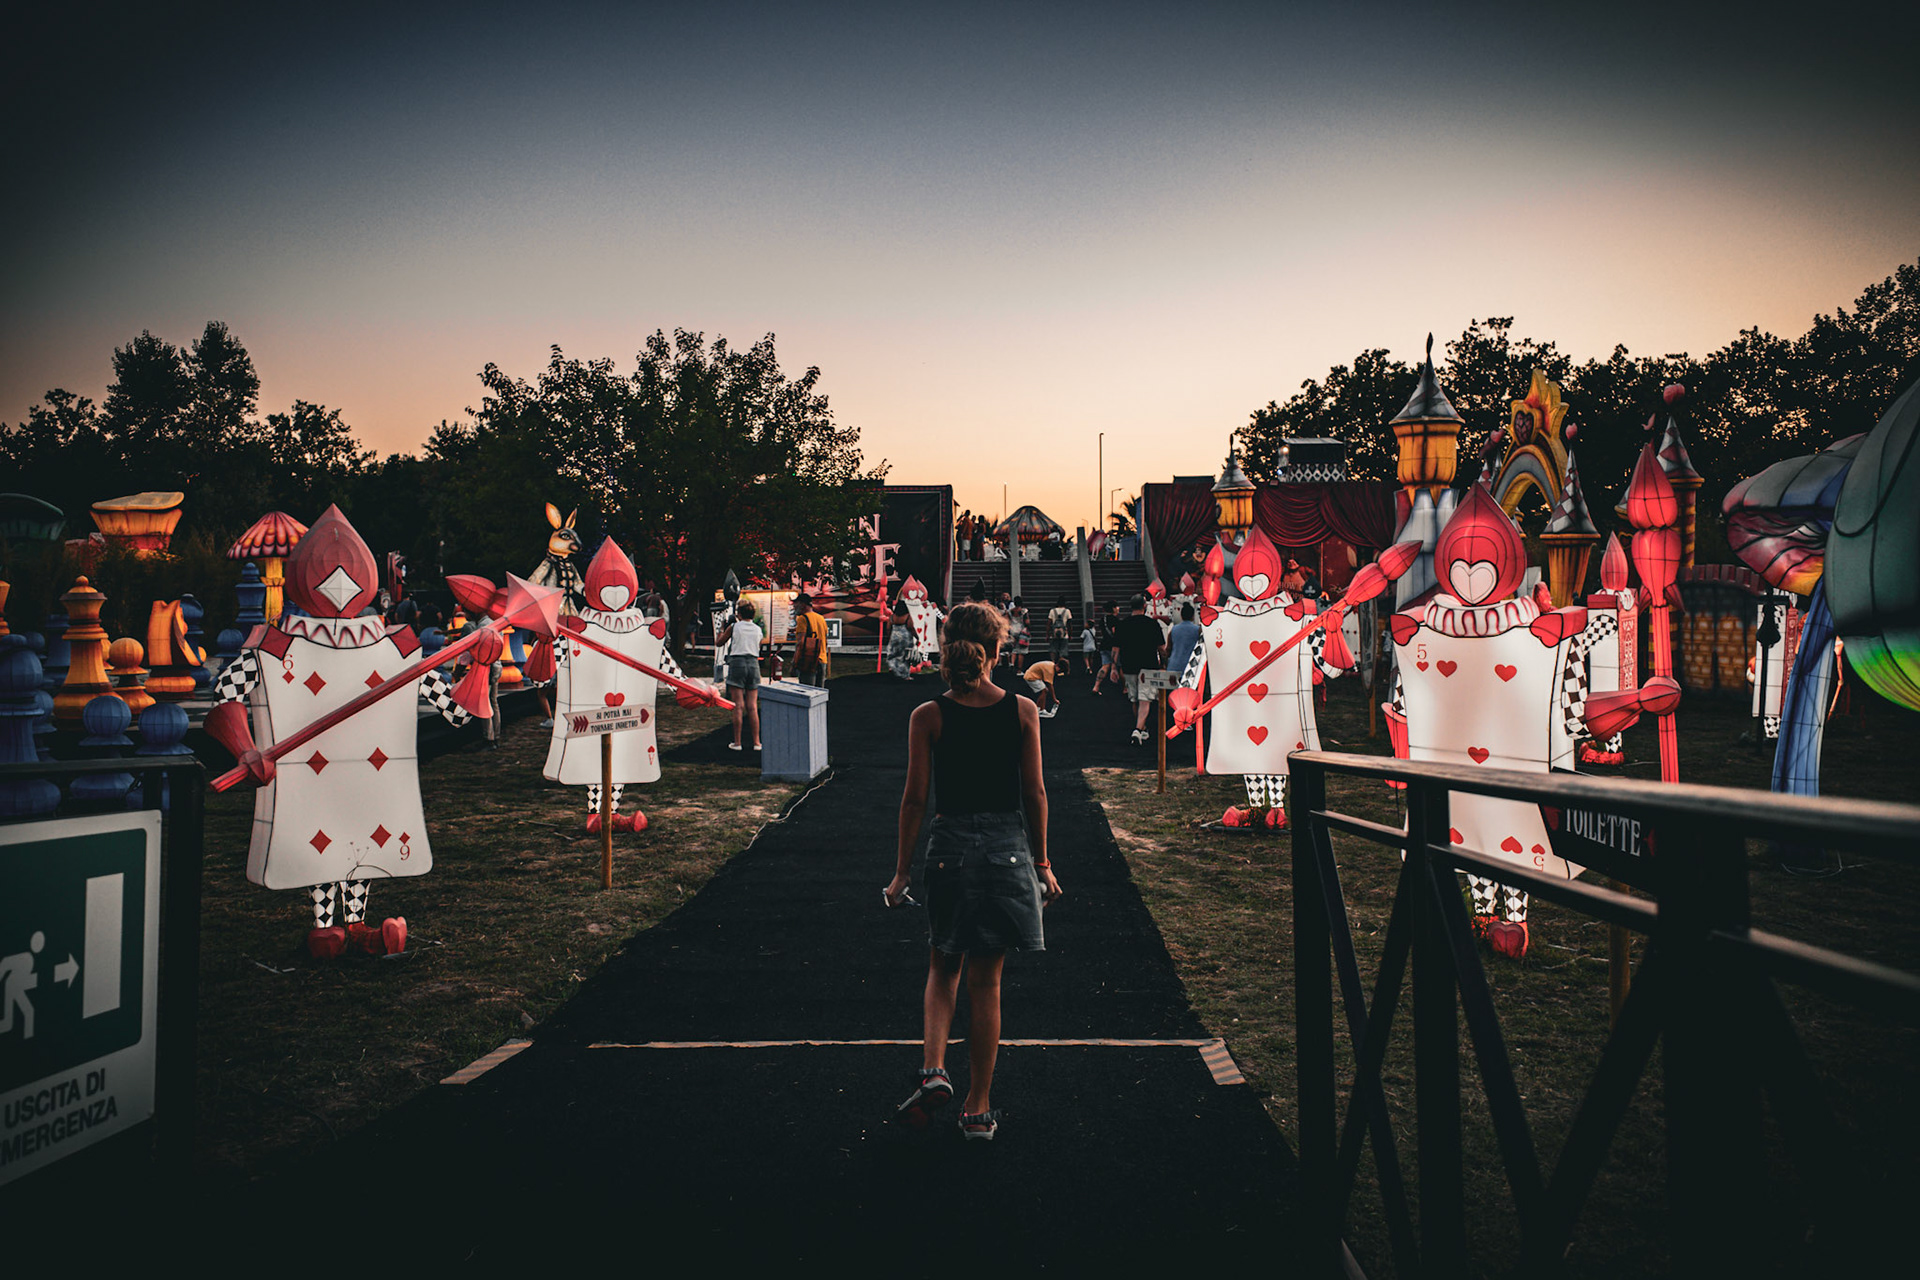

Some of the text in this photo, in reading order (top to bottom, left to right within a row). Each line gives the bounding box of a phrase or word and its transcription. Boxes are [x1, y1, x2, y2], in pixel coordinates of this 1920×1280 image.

[1216, 627, 1223, 641] 3
[1417, 644, 1427, 660] 5
[282, 653, 294, 671] 6
[622, 708, 632, 717] MAI
[590, 720, 638, 733] TORNARE INDIETRO
[1564, 807, 1641, 857] TOILETTE
[4, 1068, 105, 1129] USCITA DI
[0, 1095, 118, 1167] MERGENZA
